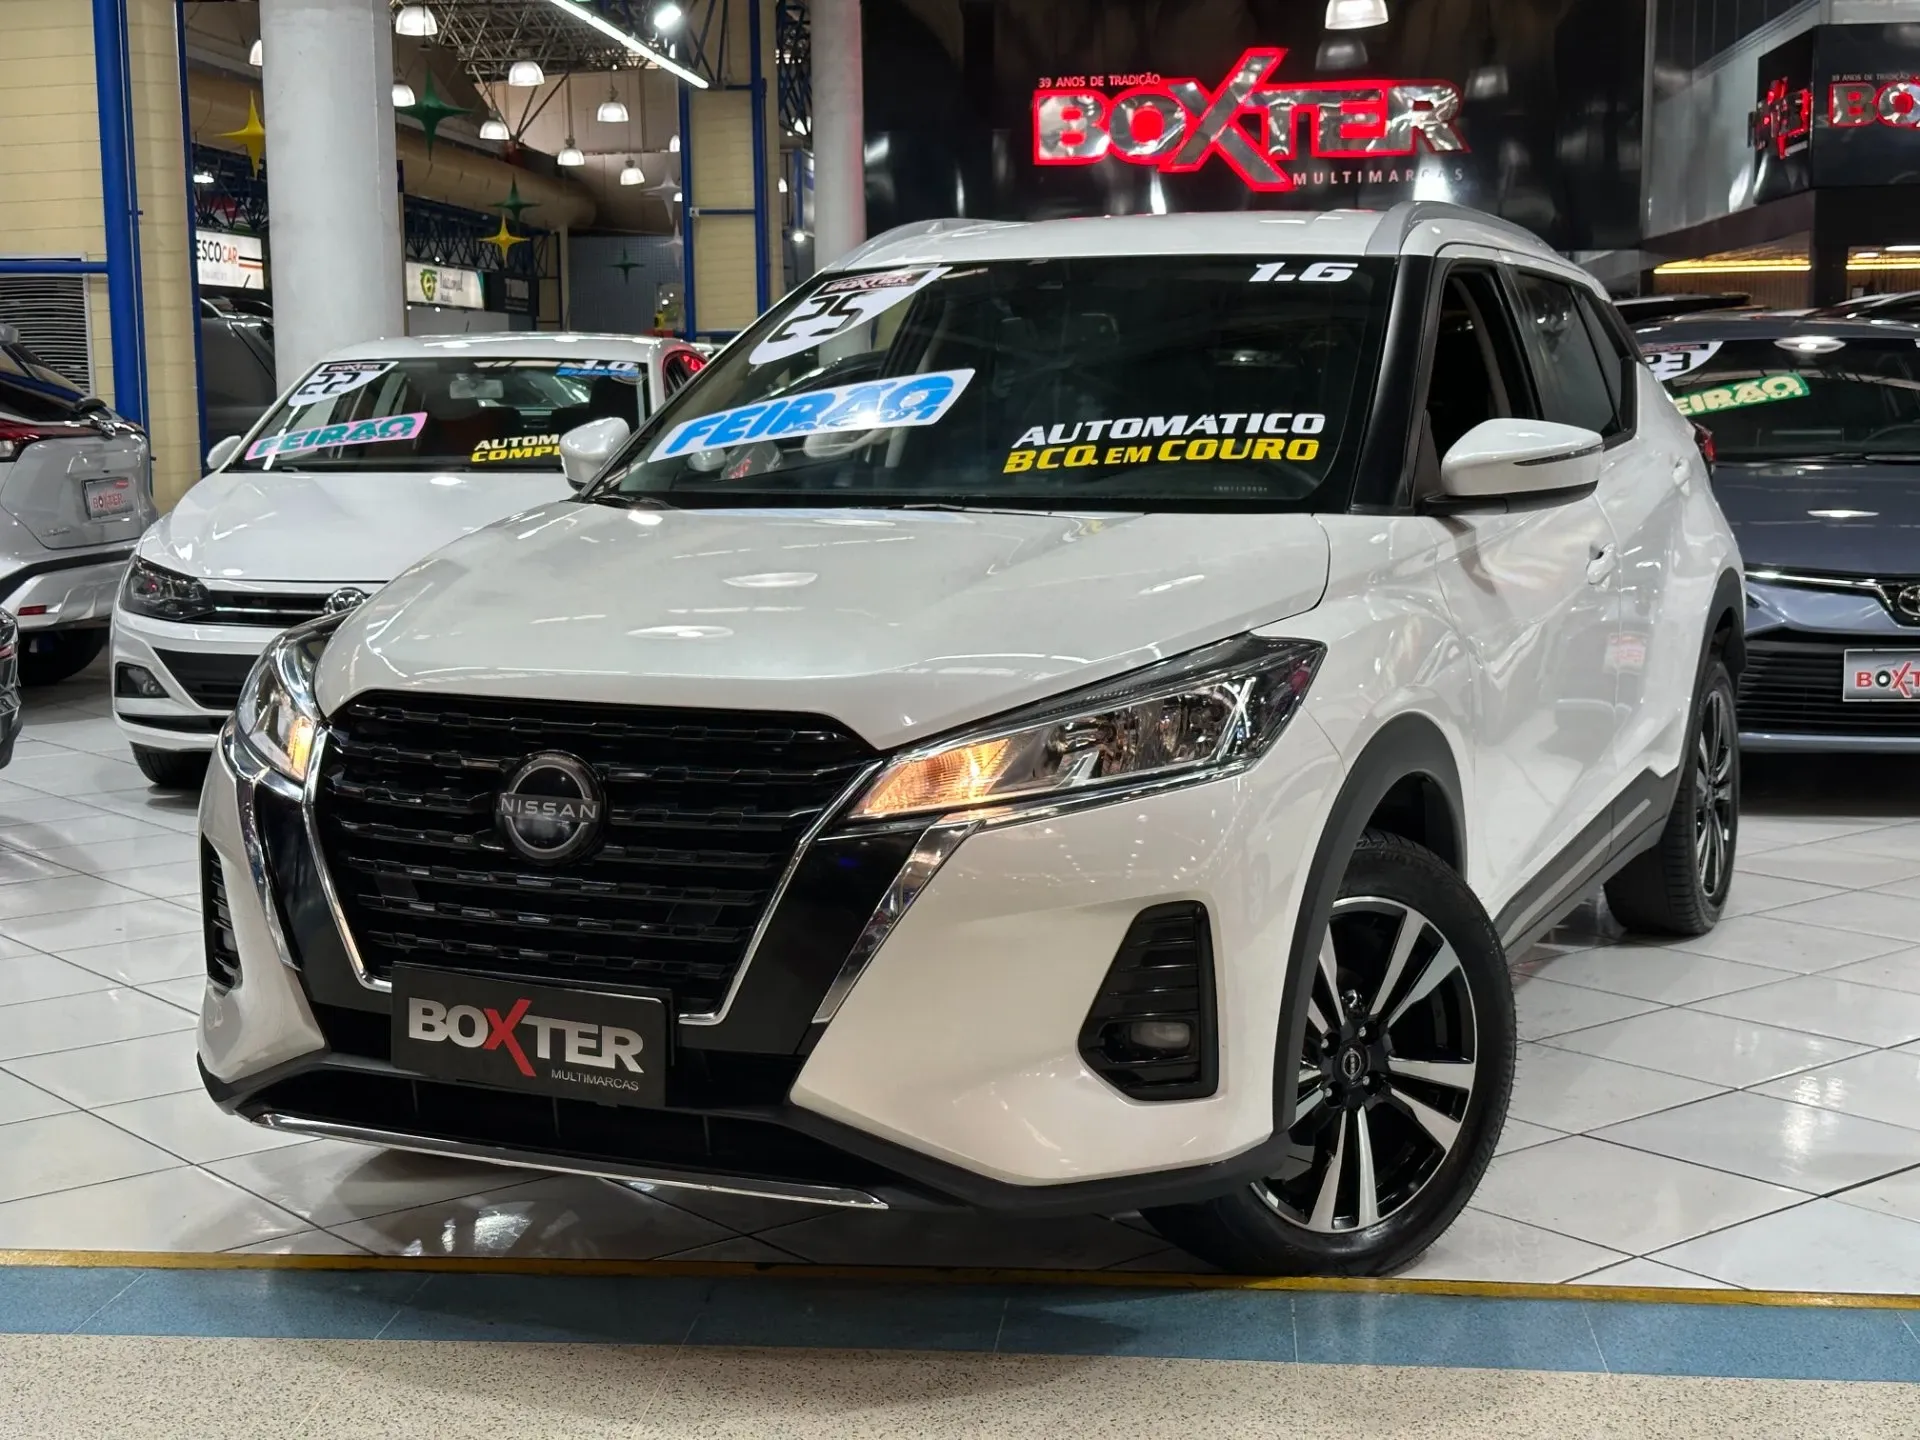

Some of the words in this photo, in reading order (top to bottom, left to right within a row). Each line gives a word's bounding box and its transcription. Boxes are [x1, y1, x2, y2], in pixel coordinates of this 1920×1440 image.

[1038, 77, 1052, 88] 39
[1055, 76, 1085, 87] ANOS
[1090, 76, 1104, 87] DE
[1109, 71, 1161, 86] TRADIÇÃO
[1829, 76, 1920, 130] BO
[1034, 47, 1470, 192] BOXTER
[1292, 168, 1463, 186] MULTIMARCAS
[1249, 262, 1359, 282] 1.6
[767, 289, 883, 343] 25
[583, 360, 637, 372] 1.0
[297, 372, 361, 396] 22
[665, 375, 955, 455] FEIRÃO
[254, 416, 417, 456] FEIRÃO
[474, 434, 560, 451] AUTOM
[1104, 445, 1152, 465] EM
[1158, 438, 1320, 462] COURO
[501, 798, 597, 819] NISSAN
[408, 997, 645, 1077] BOXTER
[551, 1068, 640, 1091] MULTIMARCAS
